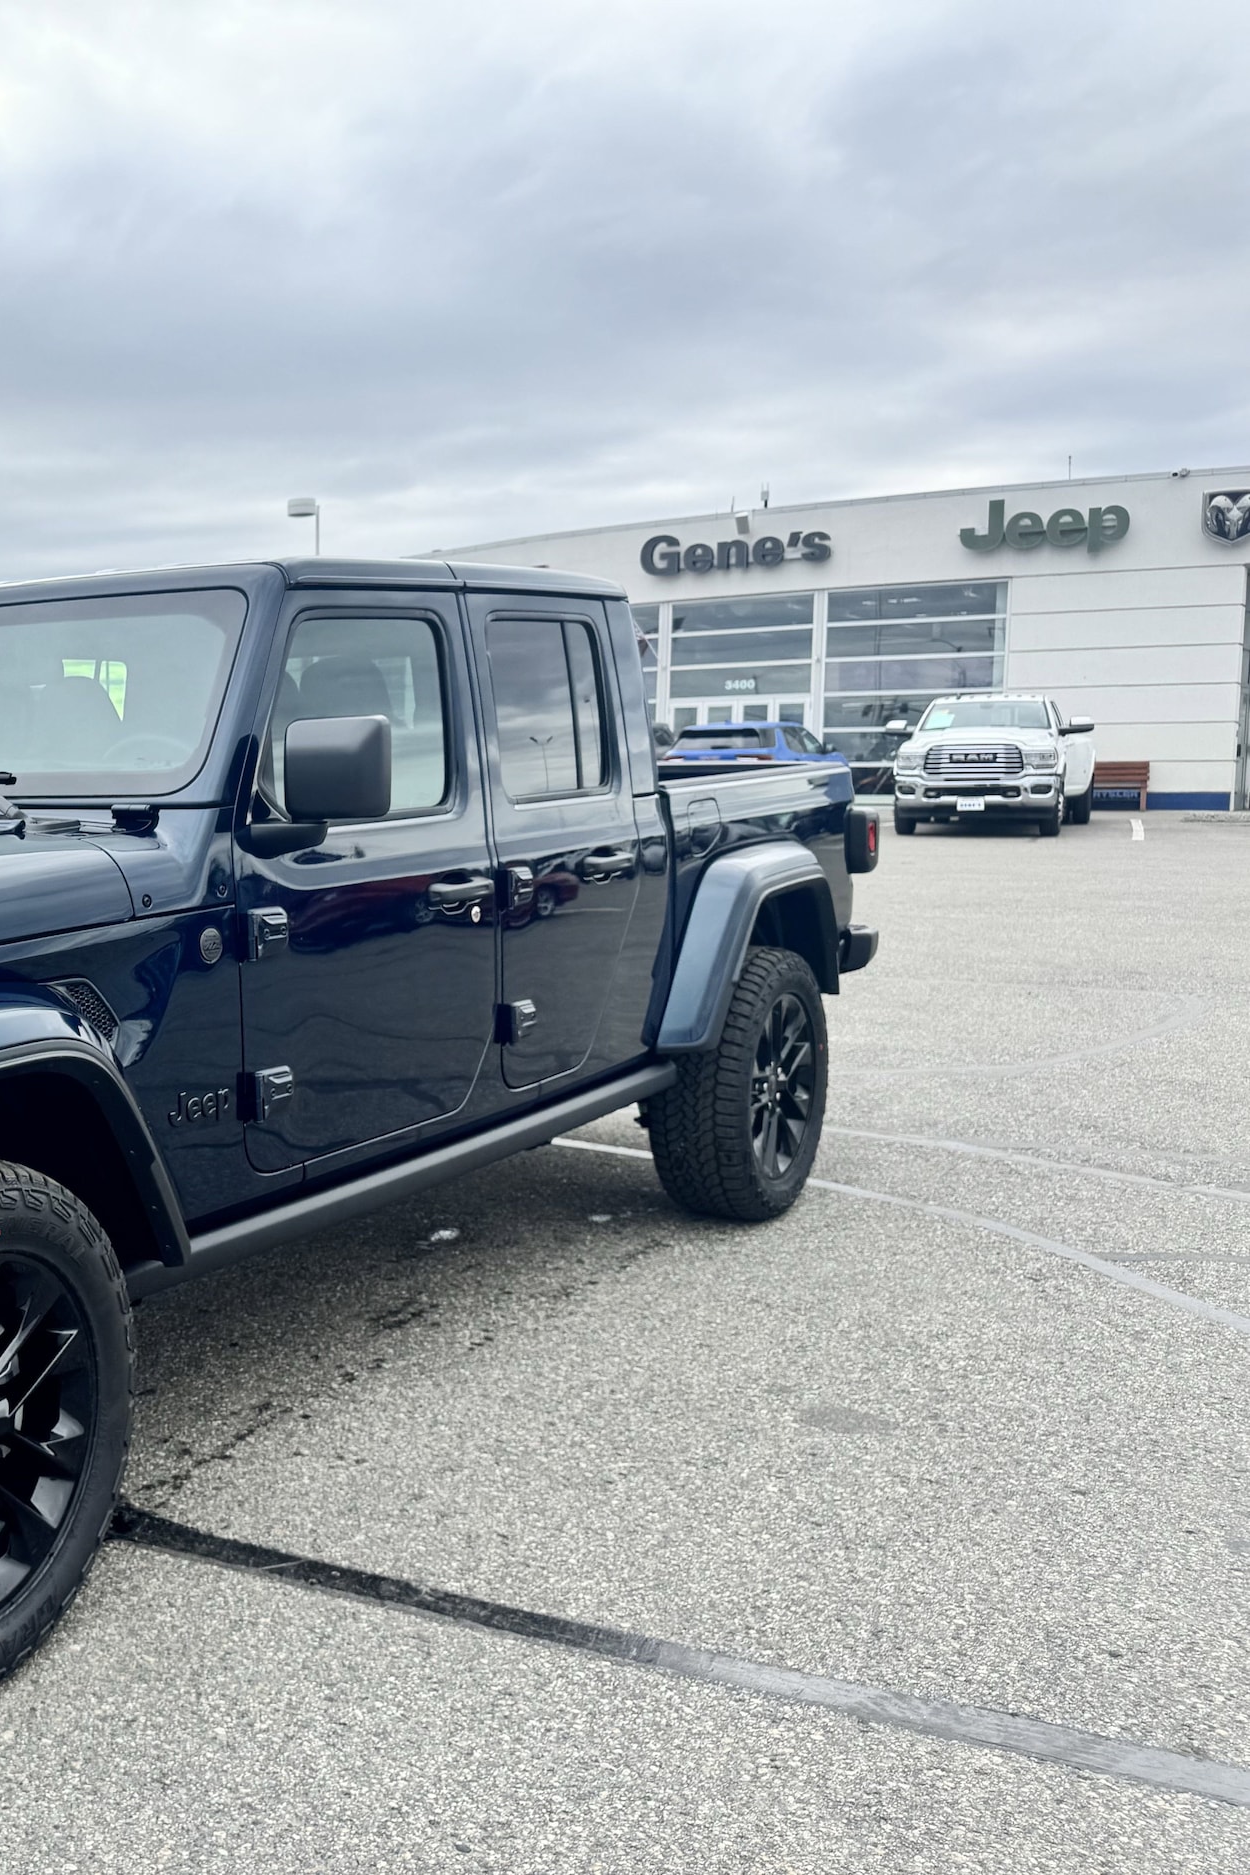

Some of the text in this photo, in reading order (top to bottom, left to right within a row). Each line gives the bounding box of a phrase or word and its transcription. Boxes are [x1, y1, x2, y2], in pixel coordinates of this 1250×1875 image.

[959, 499, 1131, 553] Jeep
[640, 531, 832, 576] Gene's
[724, 678, 756, 690] 3400
[951, 753, 994, 762] RAM
[1092, 790, 1138, 799] RYSLER
[168, 1088, 229, 1127] Jeep
